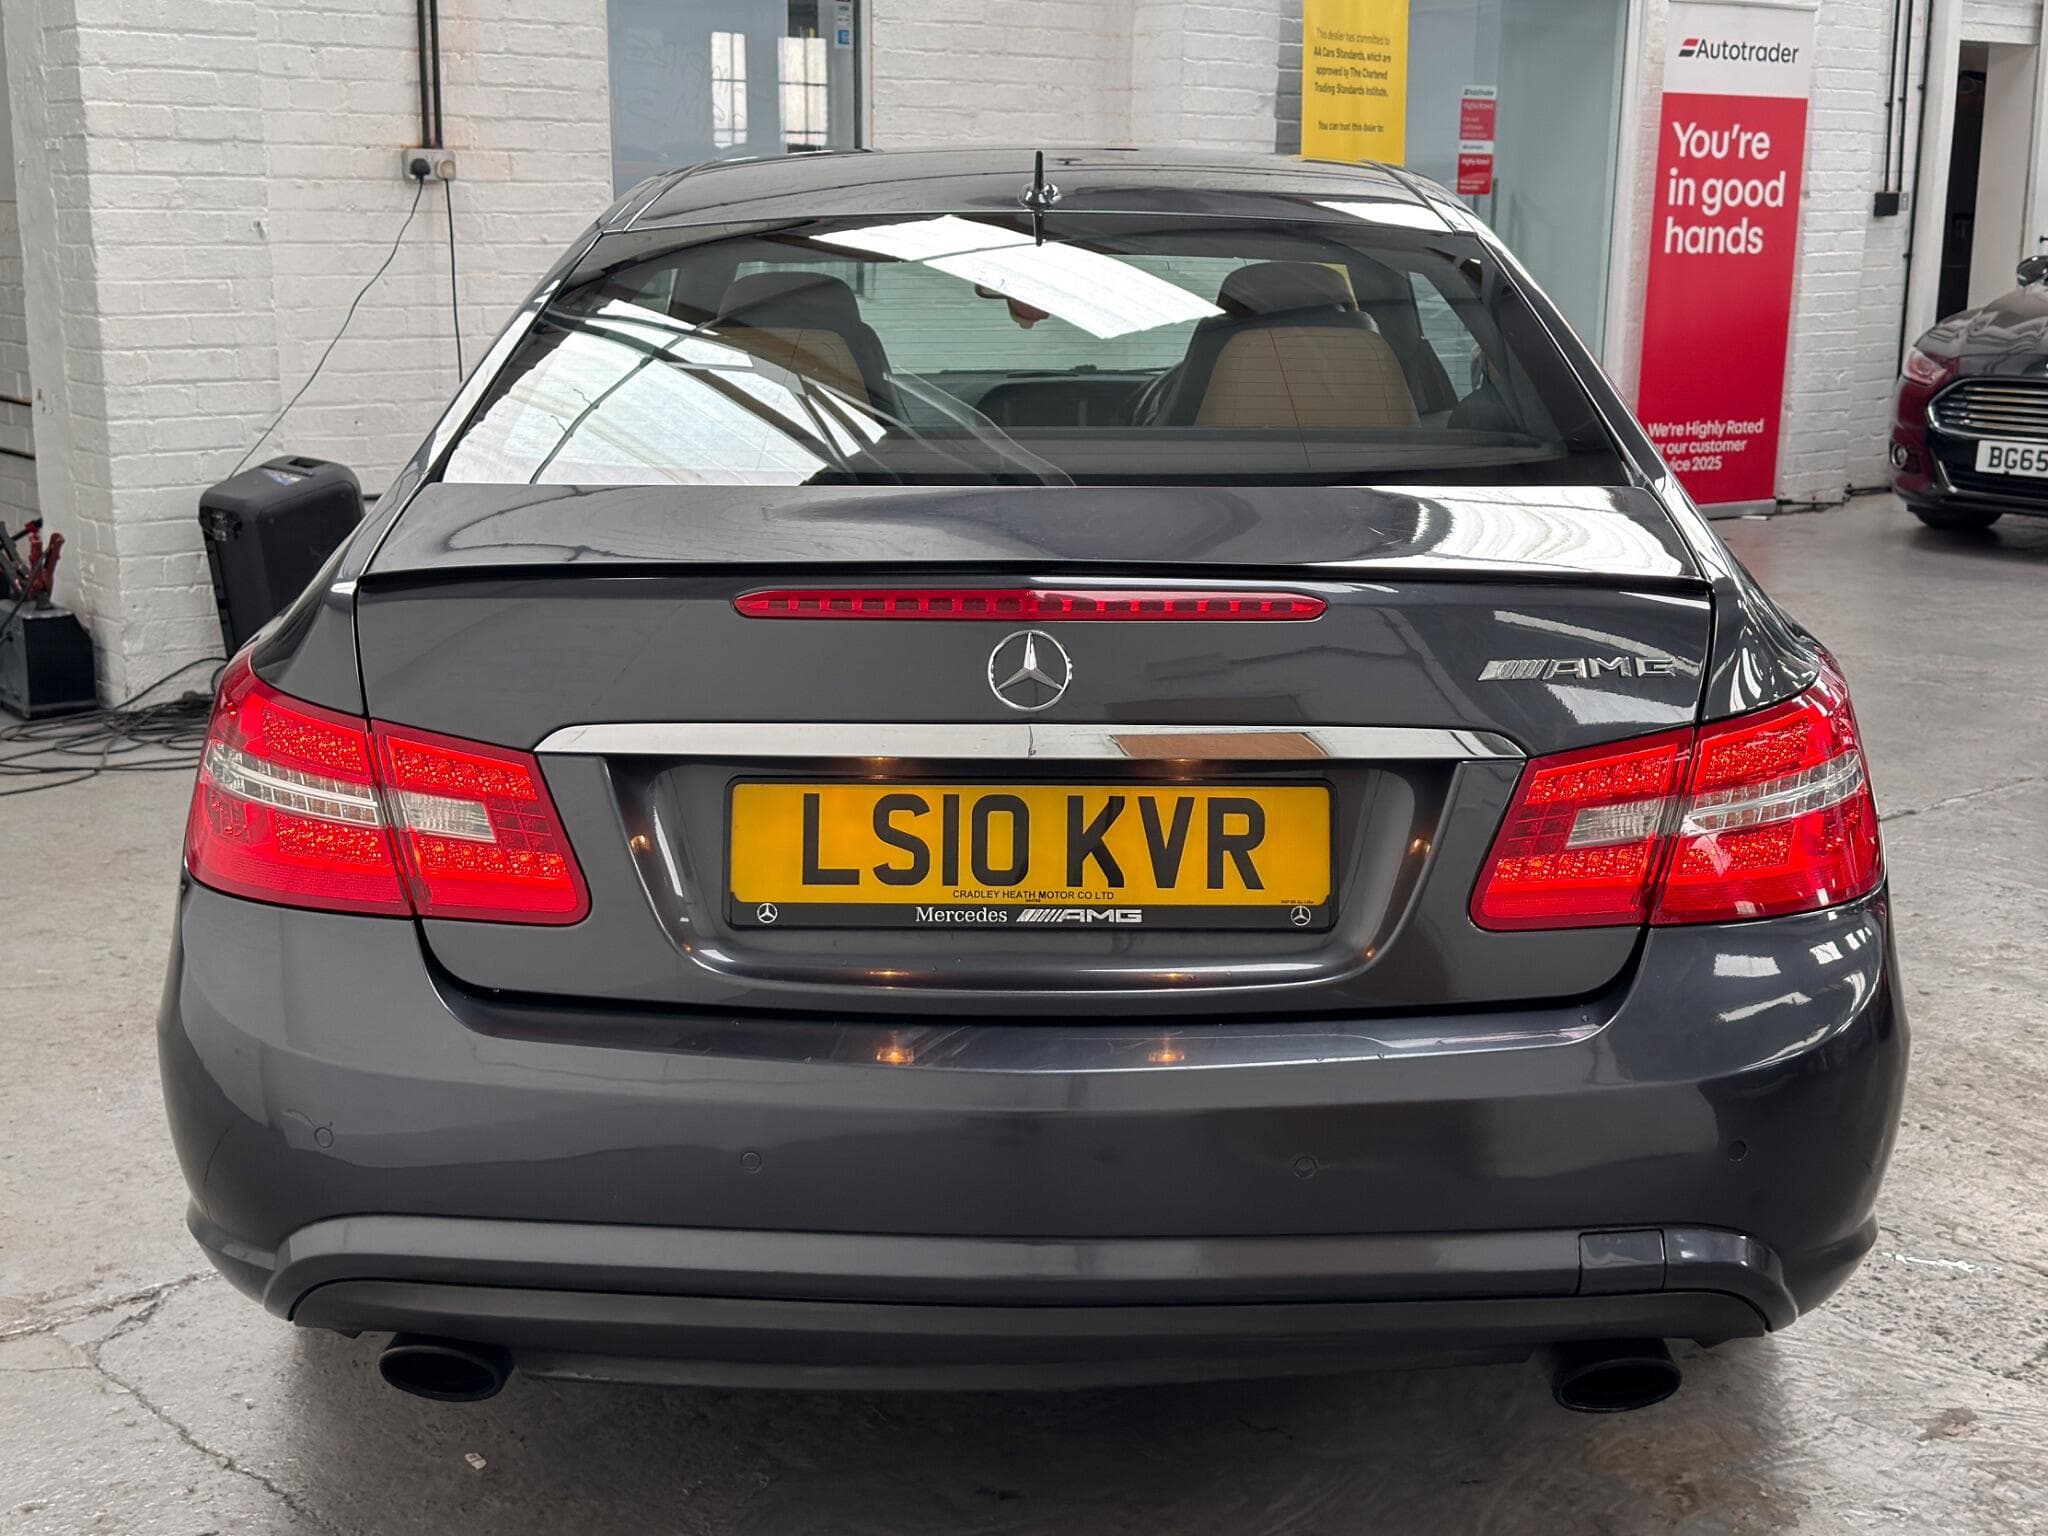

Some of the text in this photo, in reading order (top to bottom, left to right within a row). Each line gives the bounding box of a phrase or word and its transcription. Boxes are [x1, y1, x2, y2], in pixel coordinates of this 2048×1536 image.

[1696, 39, 1799, 64] Autotrader
[1668, 167, 1786, 217] in good
[1664, 216, 1764, 254] hands
[1685, 421, 1726, 439] Highly
[1727, 418, 1764, 434] Rated
[1666, 443, 1688, 455] our
[1689, 440, 1747, 453] customer
[1988, 446, 2048, 472] BG65
[1691, 456, 1723, 472] 2025
[1542, 656, 1677, 680] AMG
[802, 793, 1265, 889] LS10 KVR
[953, 889, 1114, 900] CRADLEY HEATH MOTOR CO LTD
[915, 906, 1142, 923] Mercedes AMG
